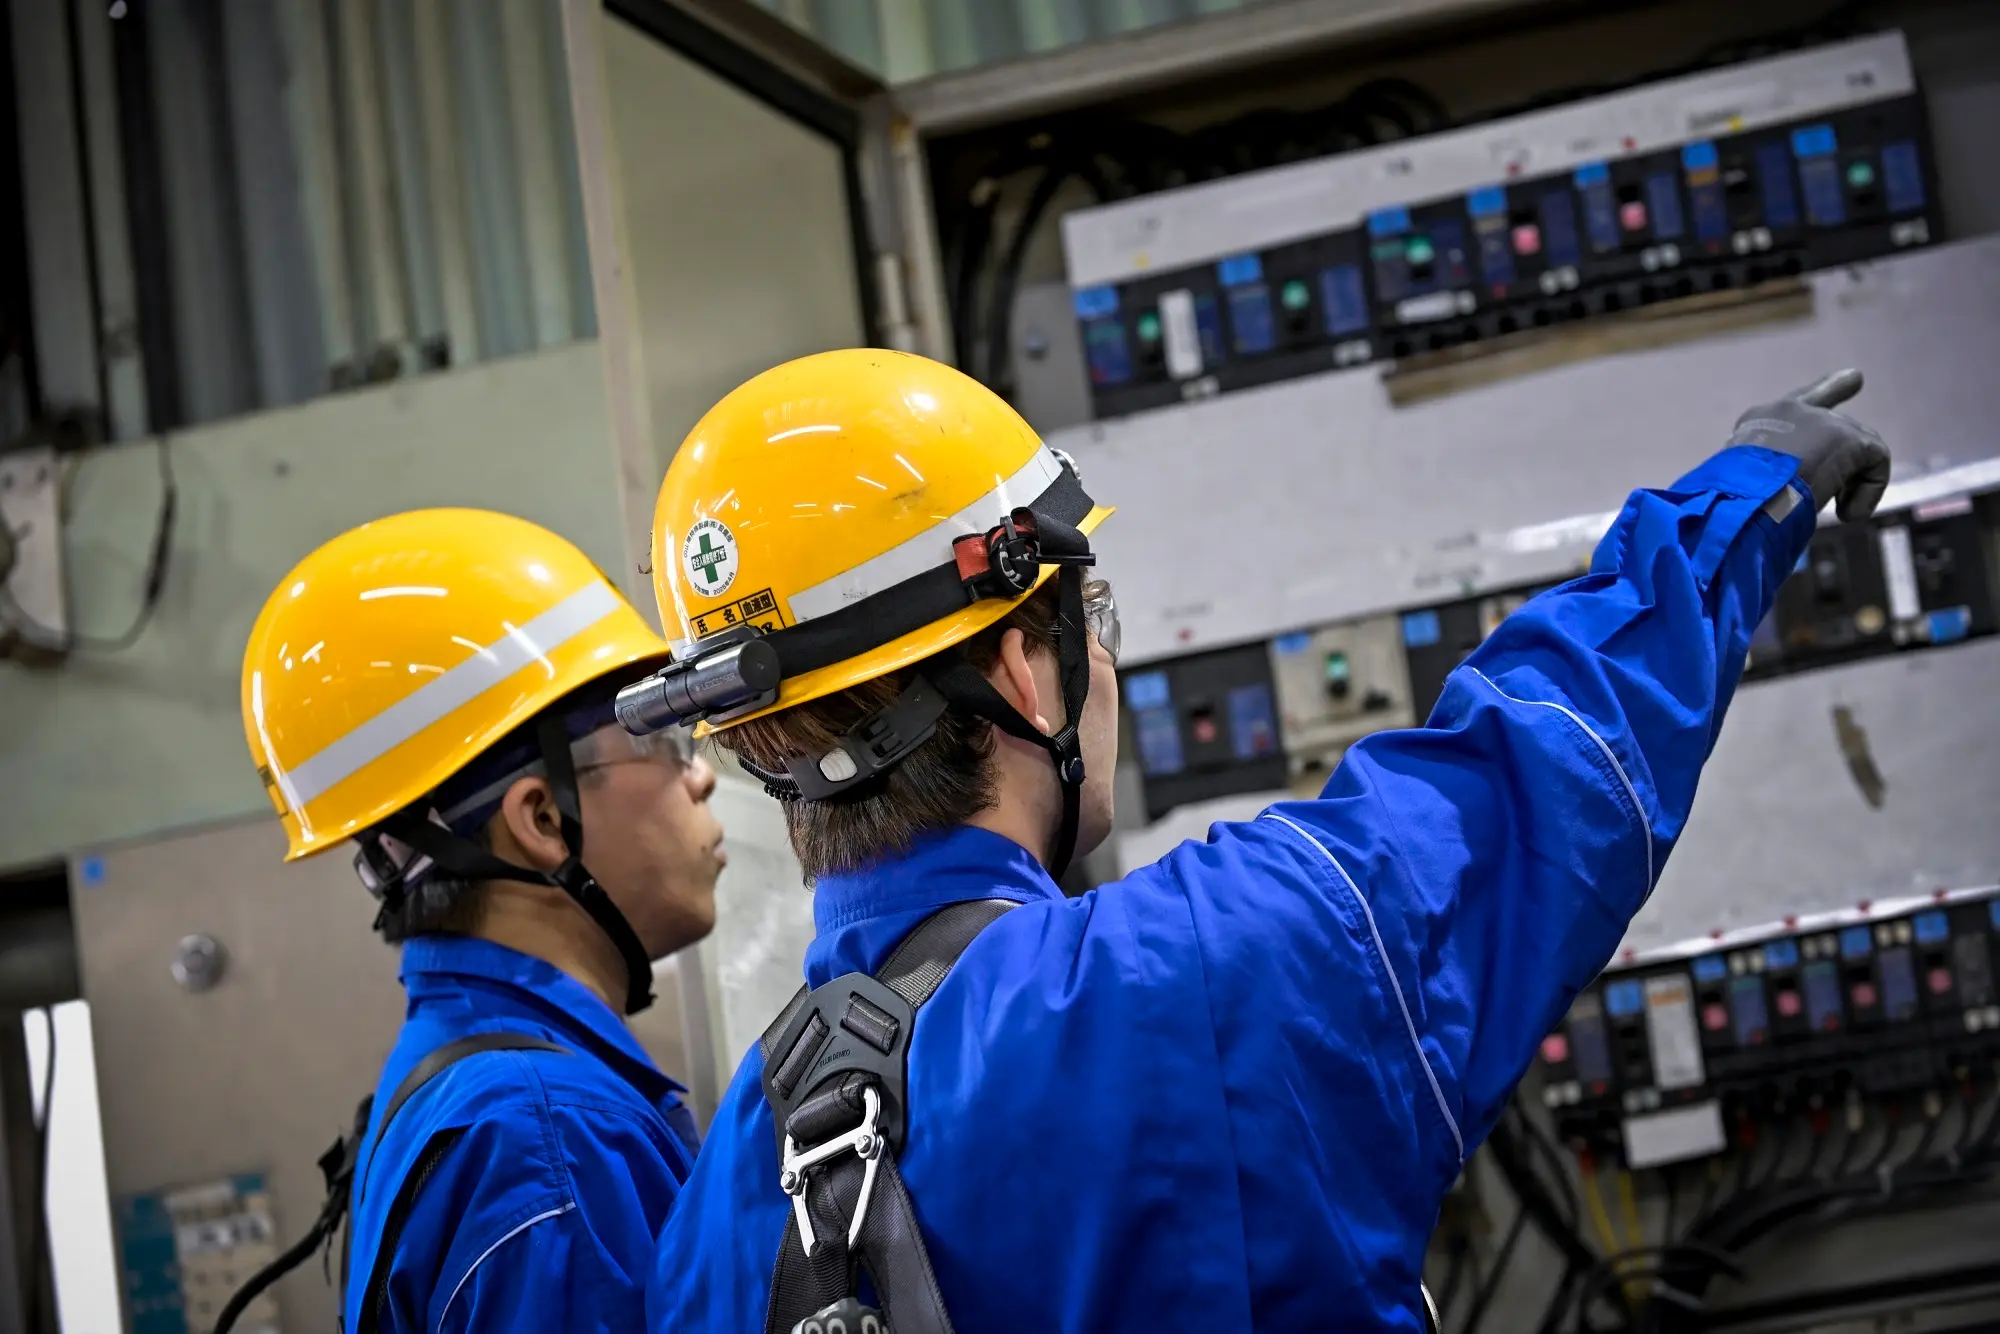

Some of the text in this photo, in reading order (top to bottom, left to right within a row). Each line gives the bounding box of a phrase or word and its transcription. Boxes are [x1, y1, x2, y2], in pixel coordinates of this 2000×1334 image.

[742, 593, 773, 617] 血液型
[697, 608, 737, 634] 氏 名
